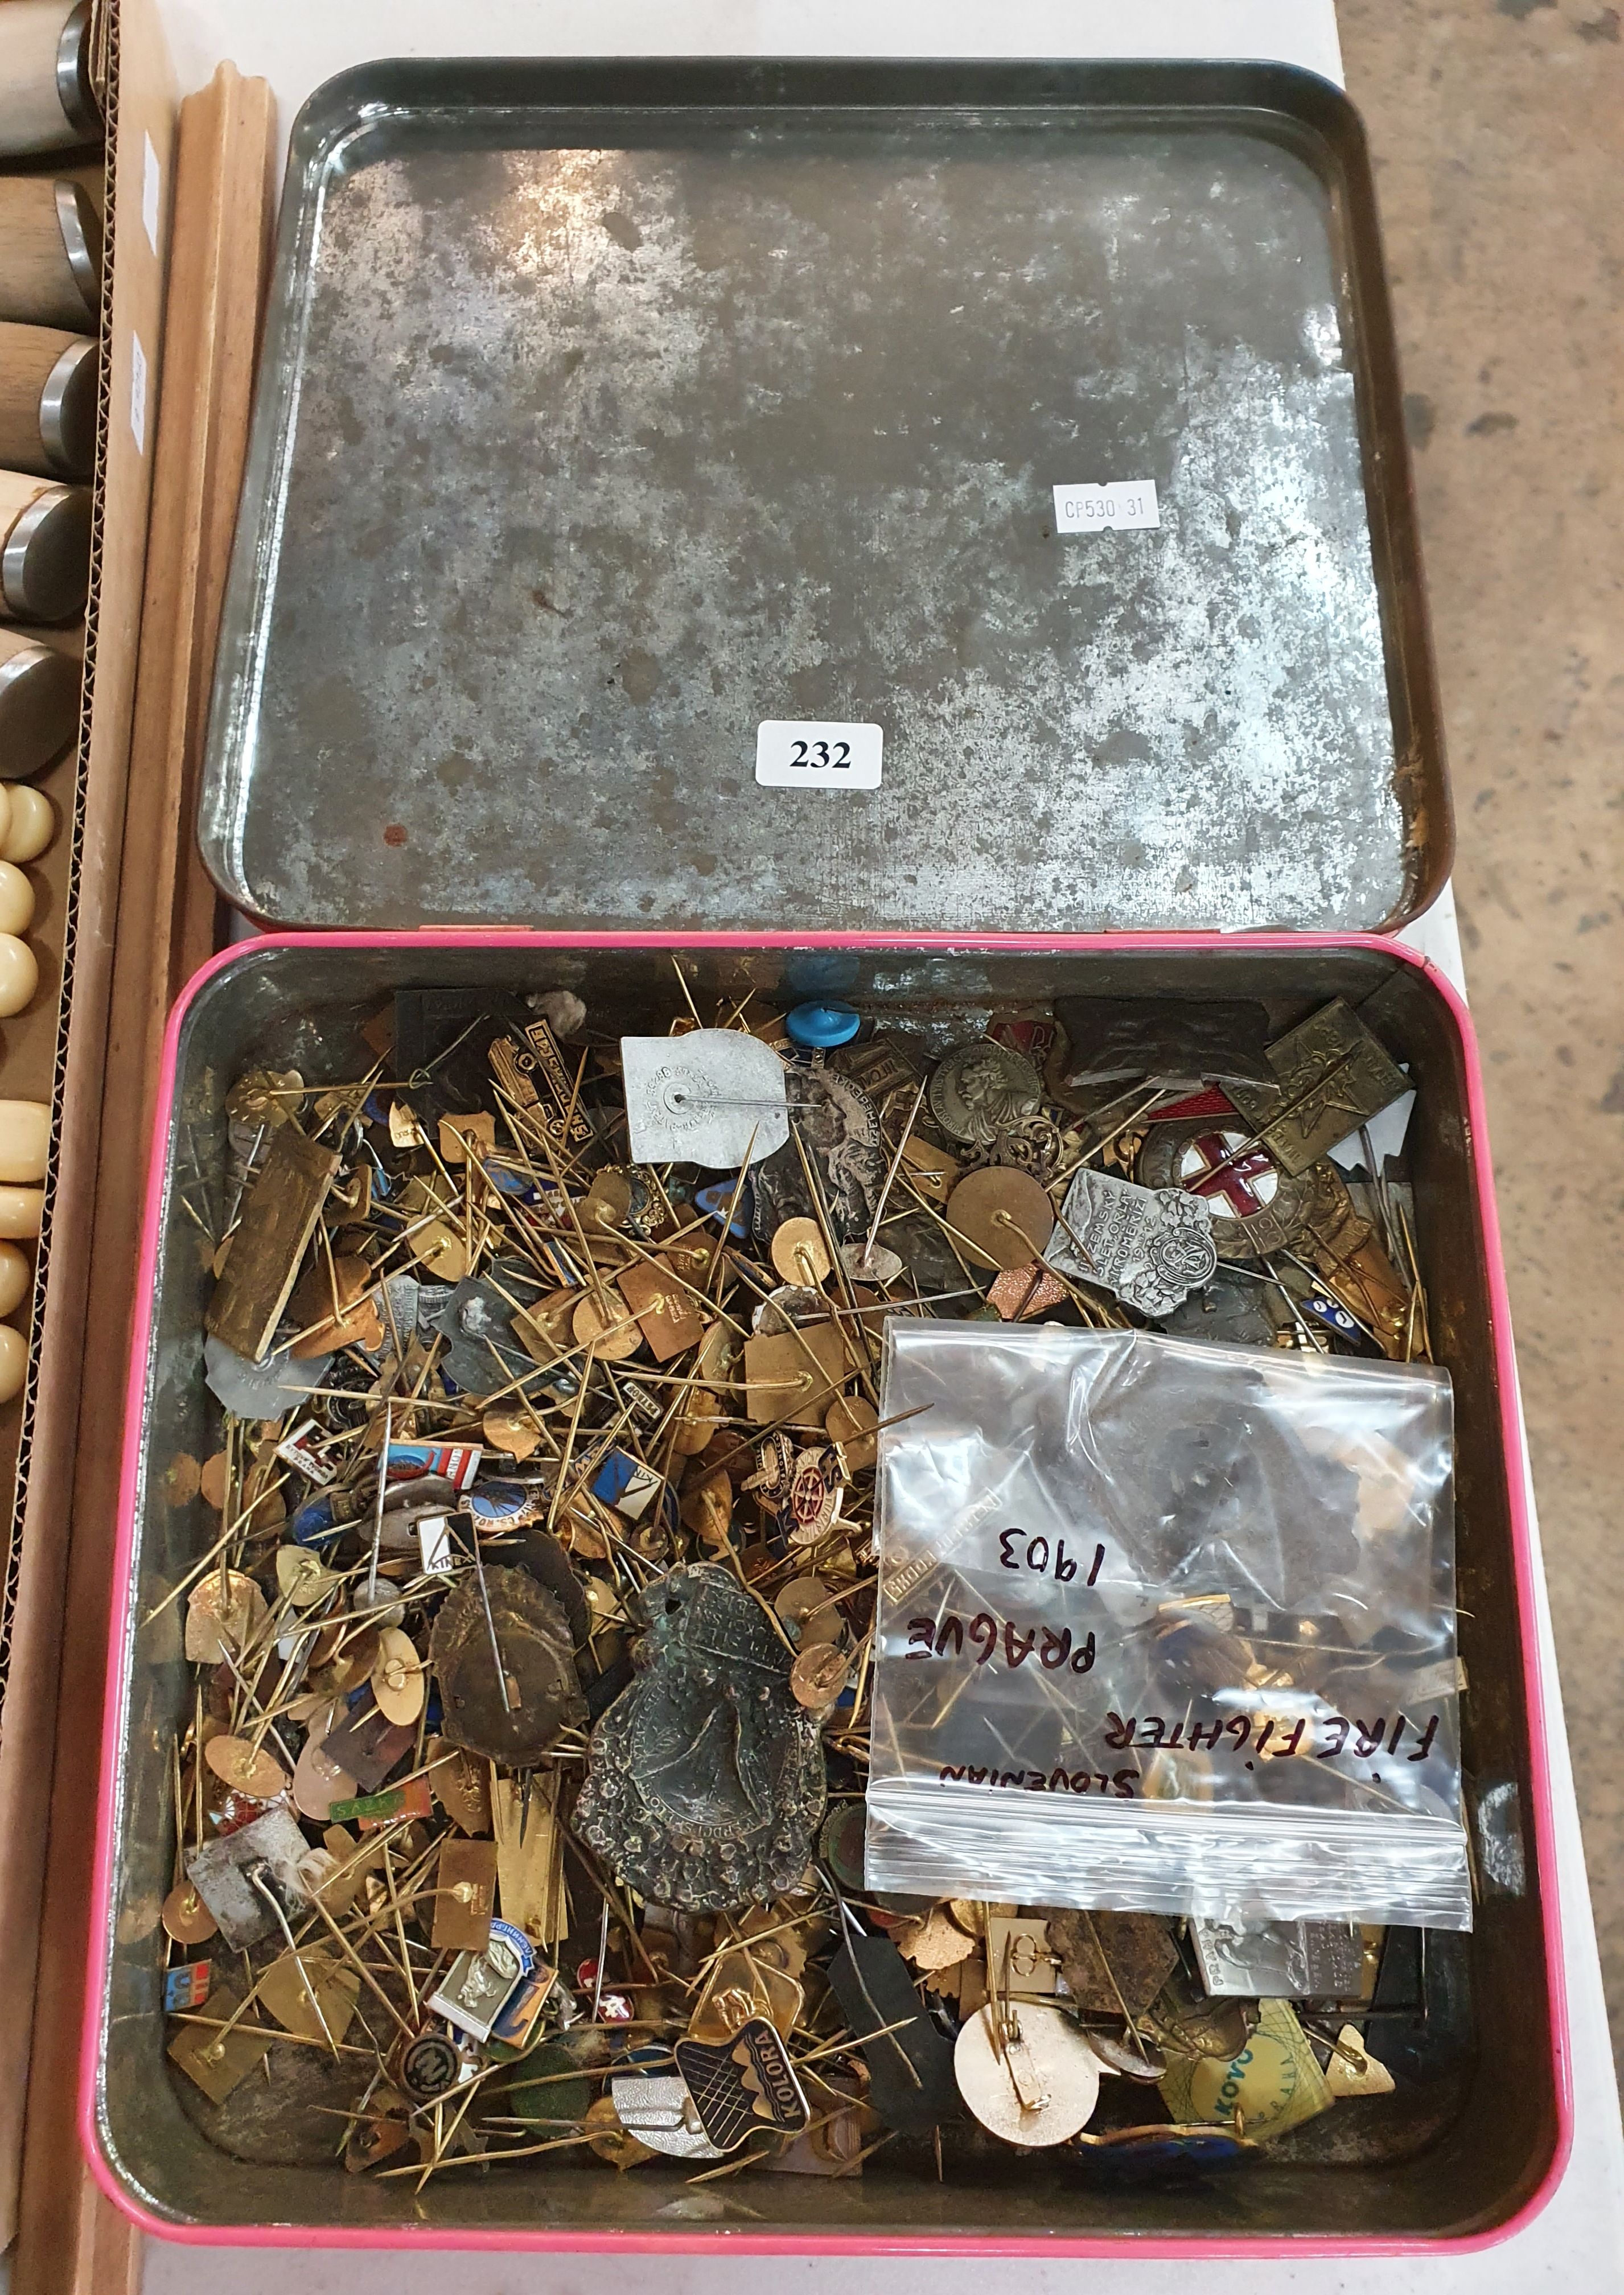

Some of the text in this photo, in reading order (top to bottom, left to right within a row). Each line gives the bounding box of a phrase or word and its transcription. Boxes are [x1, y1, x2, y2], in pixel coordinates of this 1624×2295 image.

[1065, 497, 1144, 519] CP530 31
[789, 740, 852, 769] 232
[999, 1528, 1105, 1587] 1903
[905, 1613, 1096, 1674] PRAGUE
[939, 1765, 1140, 1799] SLOVENIAN
[491, 1922, 532, 1955] ЛЕНИНГРА
[754, 2030, 801, 2117] KOLORA
[1214, 2047, 1255, 2116] KOVO
